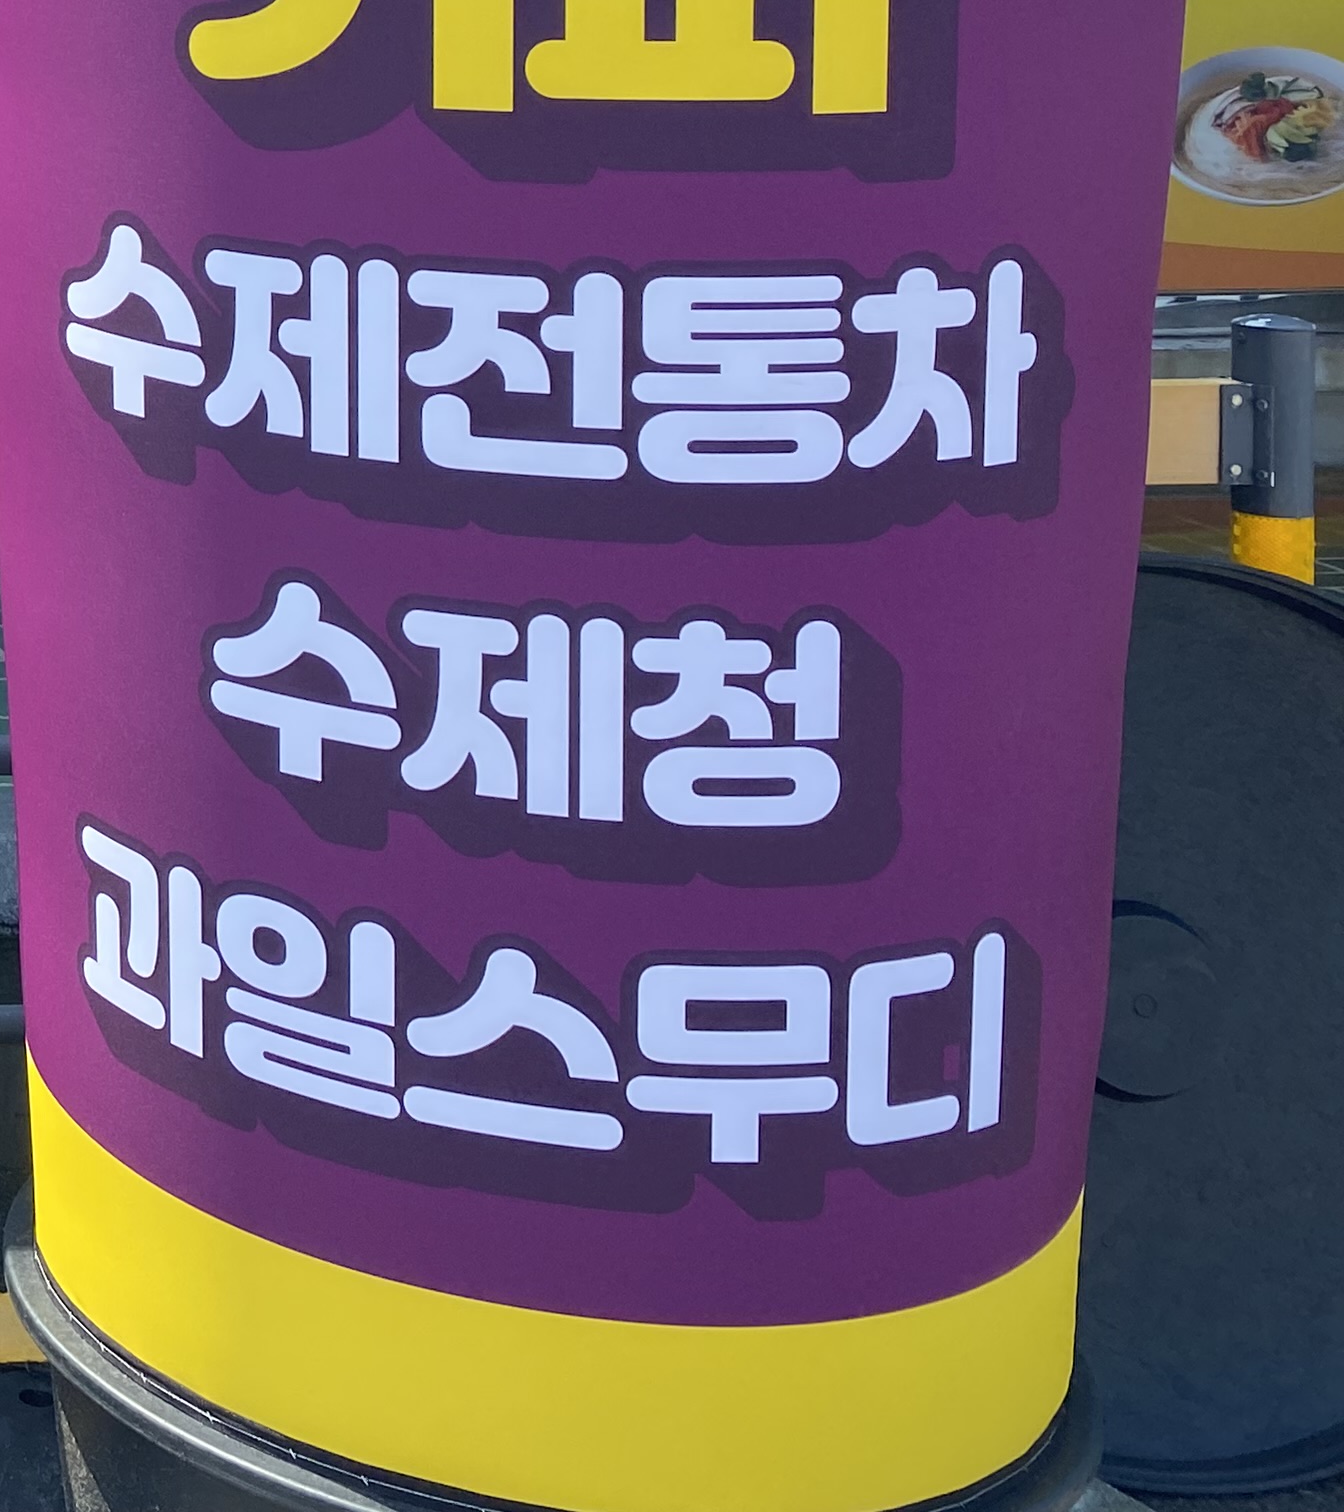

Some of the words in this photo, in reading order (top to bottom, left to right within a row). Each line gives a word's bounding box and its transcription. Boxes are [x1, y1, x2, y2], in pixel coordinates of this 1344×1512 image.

[64, 224, 1038, 485] 수제전통차
[208, 580, 841, 828] 수제청
[79, 824, 1007, 1165] 과일스무디
